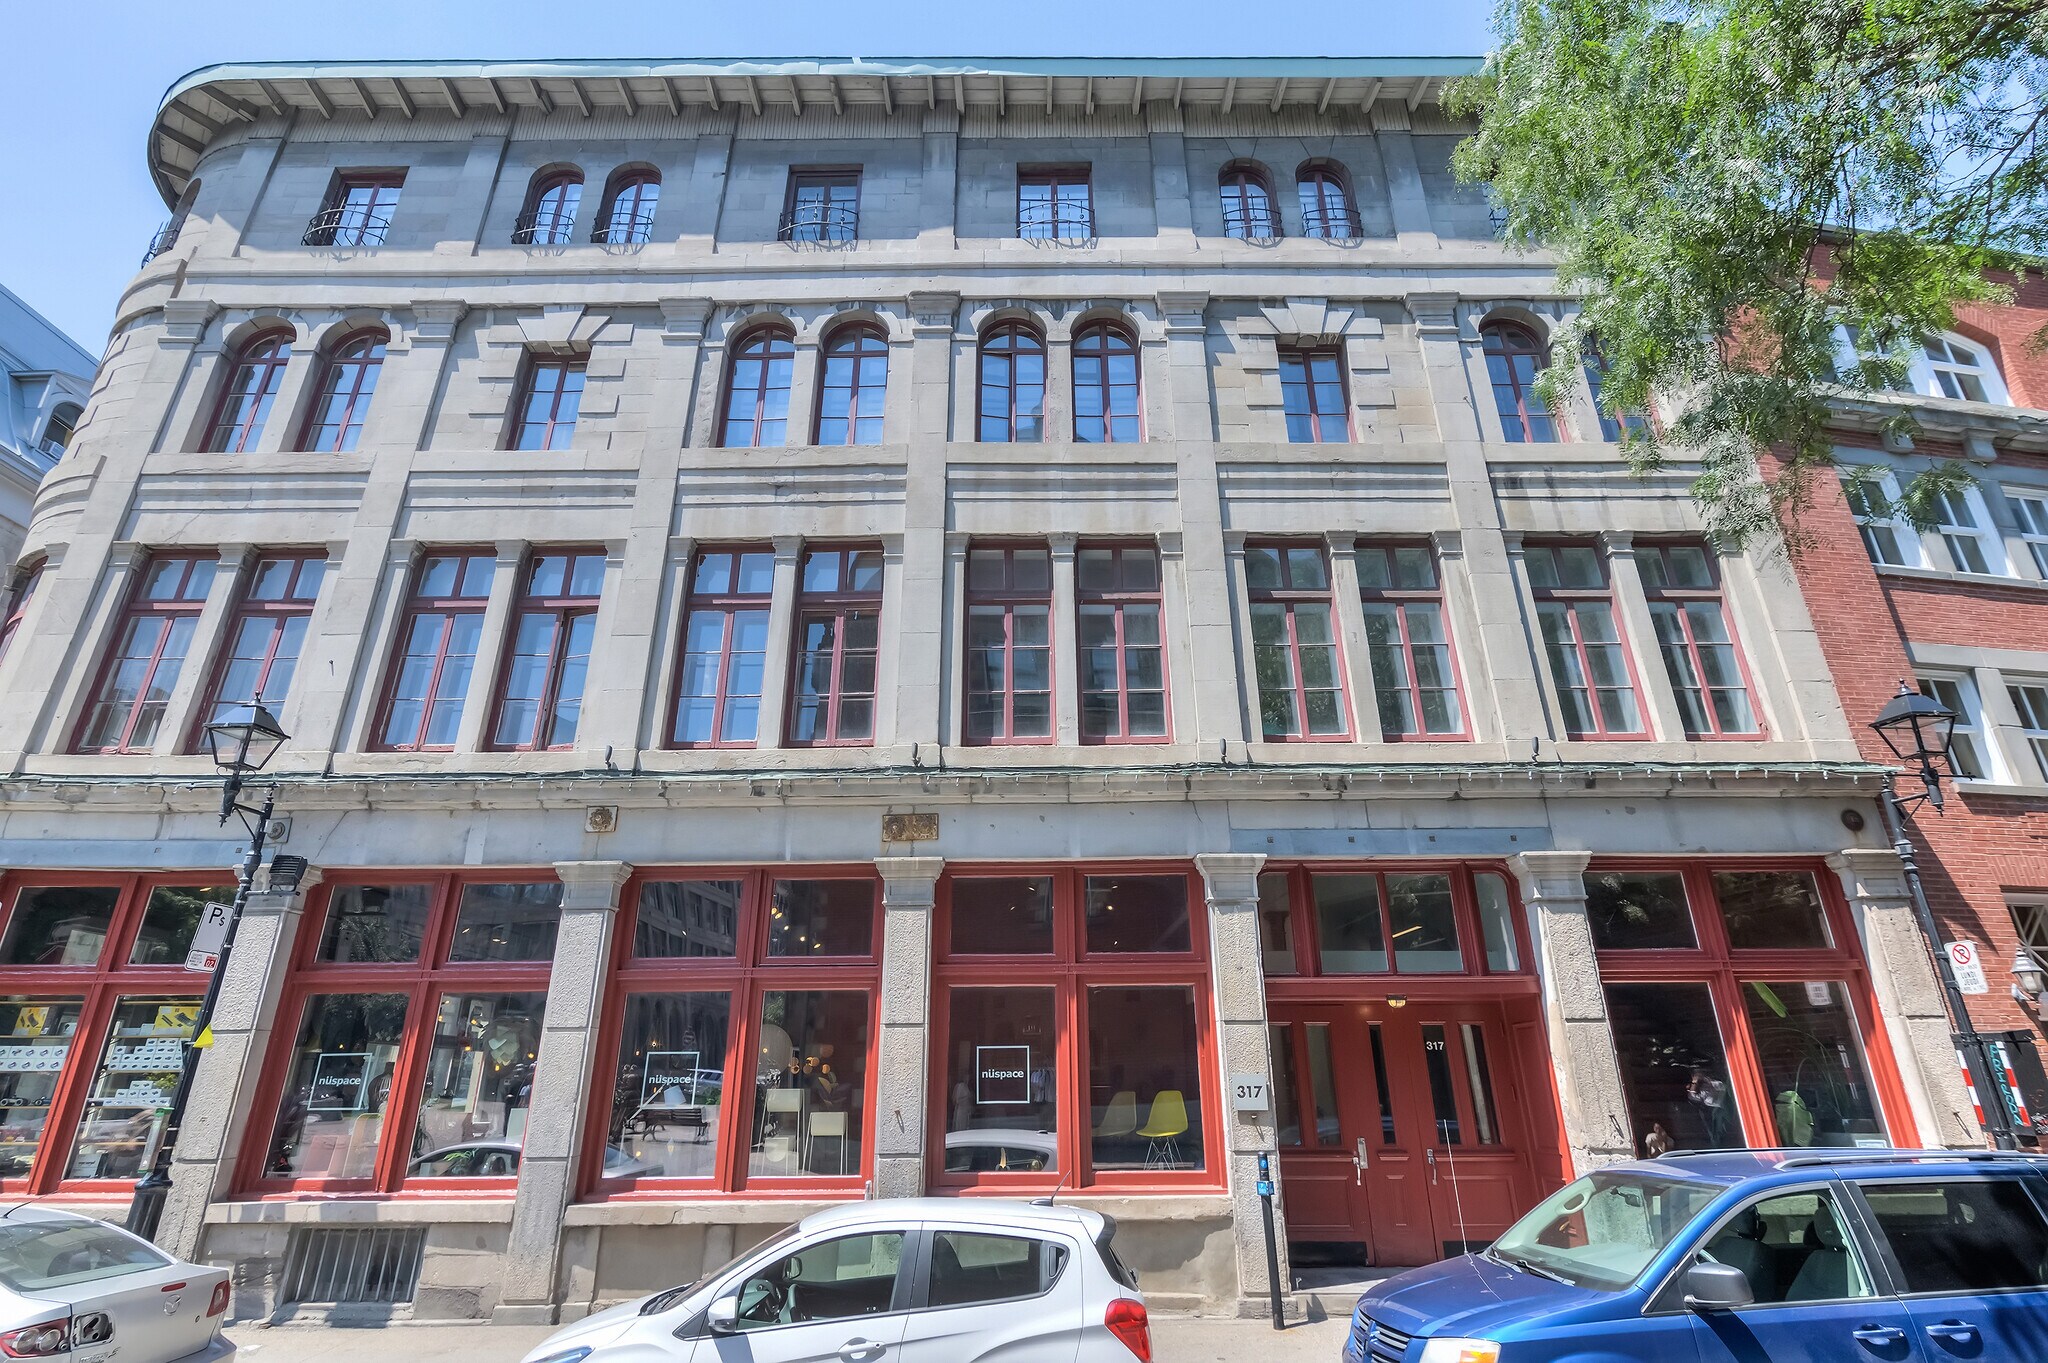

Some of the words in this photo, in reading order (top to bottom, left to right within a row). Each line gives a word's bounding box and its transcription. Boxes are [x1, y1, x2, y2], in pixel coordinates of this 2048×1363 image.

[1426, 1041, 1444, 1051] 317
[648, 1074, 691, 1086] nüspace
[981, 1069, 1024, 1080] nüspace
[318, 1075, 361, 1087] nüspace
[1237, 1085, 1263, 1099] 317
